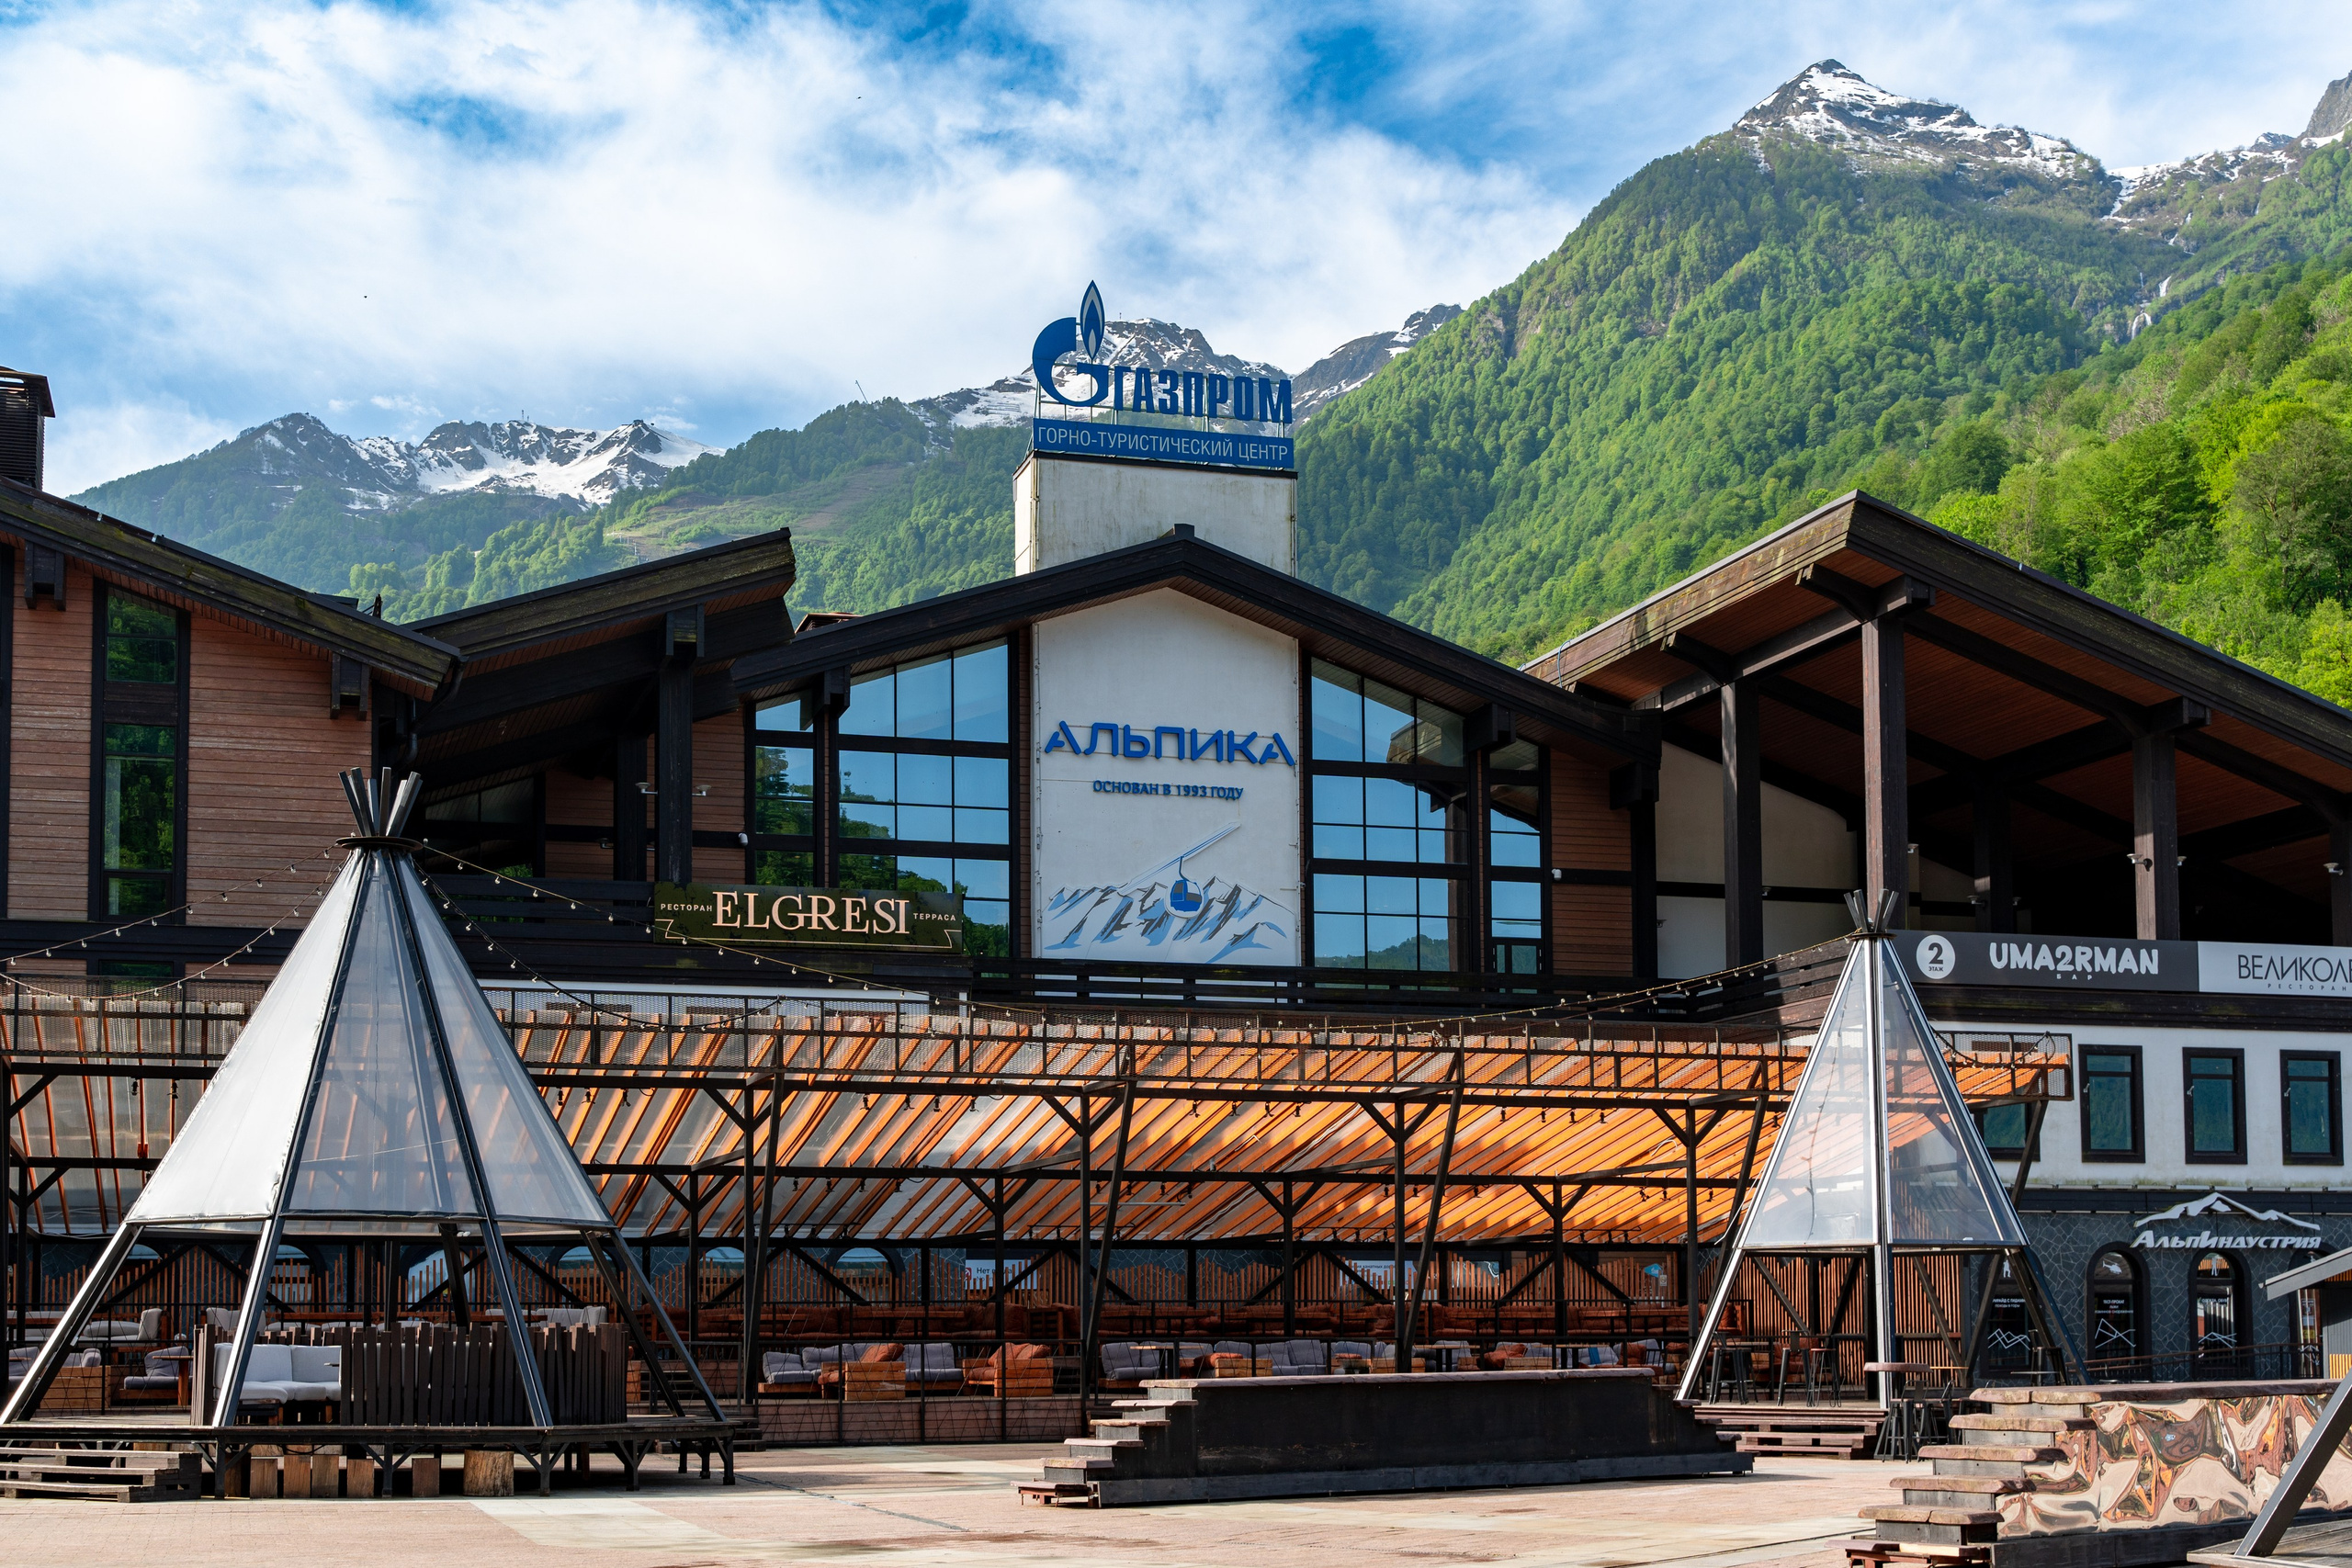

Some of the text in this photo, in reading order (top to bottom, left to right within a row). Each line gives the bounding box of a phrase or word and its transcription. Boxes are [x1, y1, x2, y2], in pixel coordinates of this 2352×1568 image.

[1114, 366, 1293, 423] ГАЗПРОМ
[1038, 426, 1288, 461] ГОРНО-ТУРИСТИЧЕСКИЙ ЦЕНТР
[1044, 720, 1295, 766] АЛЬПИКА
[1092, 780, 1244, 800] ОСНОВАН В 1993 ГОДУ
[660, 903, 713, 912] РЕСТОРАН
[712, 890, 910, 934] ELGRESI
[912, 912, 956, 921] ТЕРРАСА
[1928, 942, 1944, 964] 2
[1989, 942, 2159, 975] UMA2RMAN
[2267, 983, 2346, 991] РЕСТОРАН
